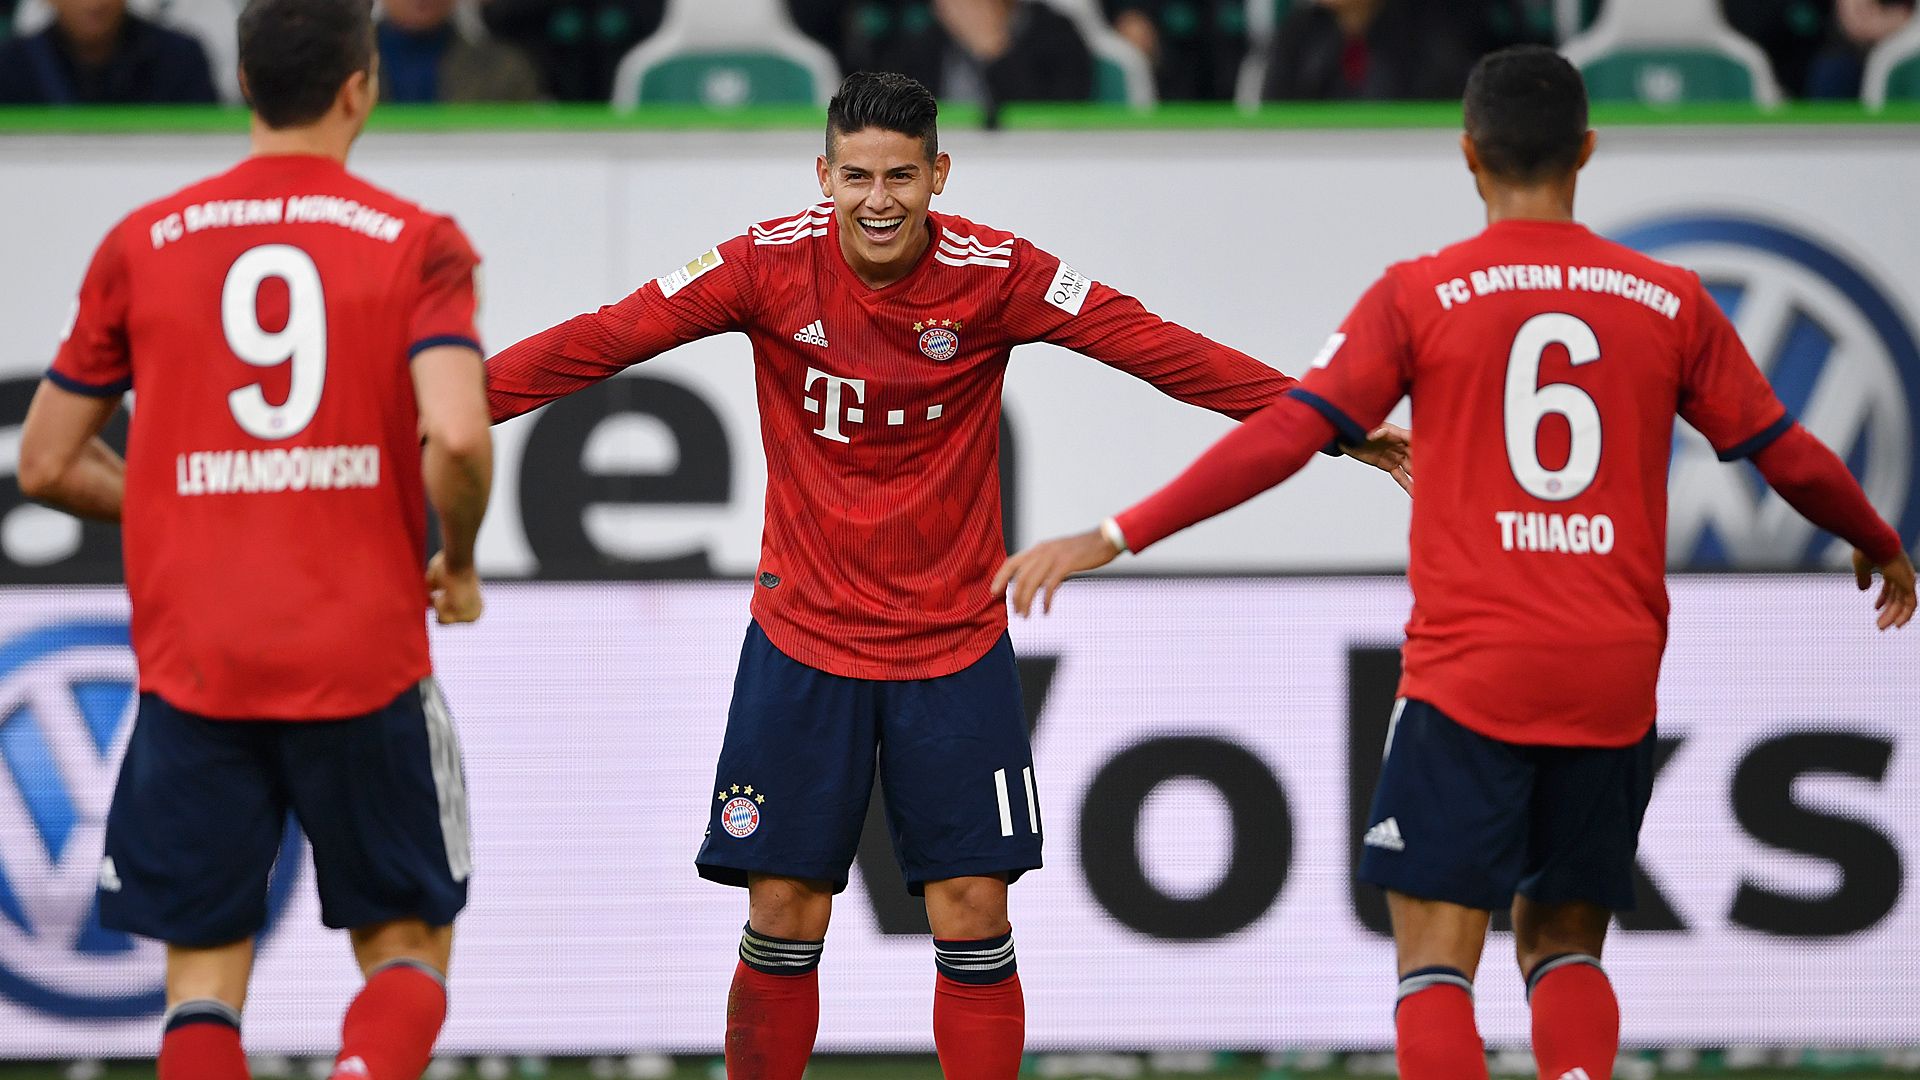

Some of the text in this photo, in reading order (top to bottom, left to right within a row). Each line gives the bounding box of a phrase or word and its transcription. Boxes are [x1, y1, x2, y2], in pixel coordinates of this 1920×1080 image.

[184, 197, 284, 233] BAYERN
[1435, 278, 1471, 310] FC
[1470, 265, 1563, 297] BAYERN
[221, 243, 327, 440] 9
[793, 332, 829, 348] adidas
[1504, 312, 1602, 501] 6
[176, 444, 380, 496] LEWANDOWSKI
[1495, 511, 1615, 555] THIAGO
[993, 766, 1039, 838] 11
